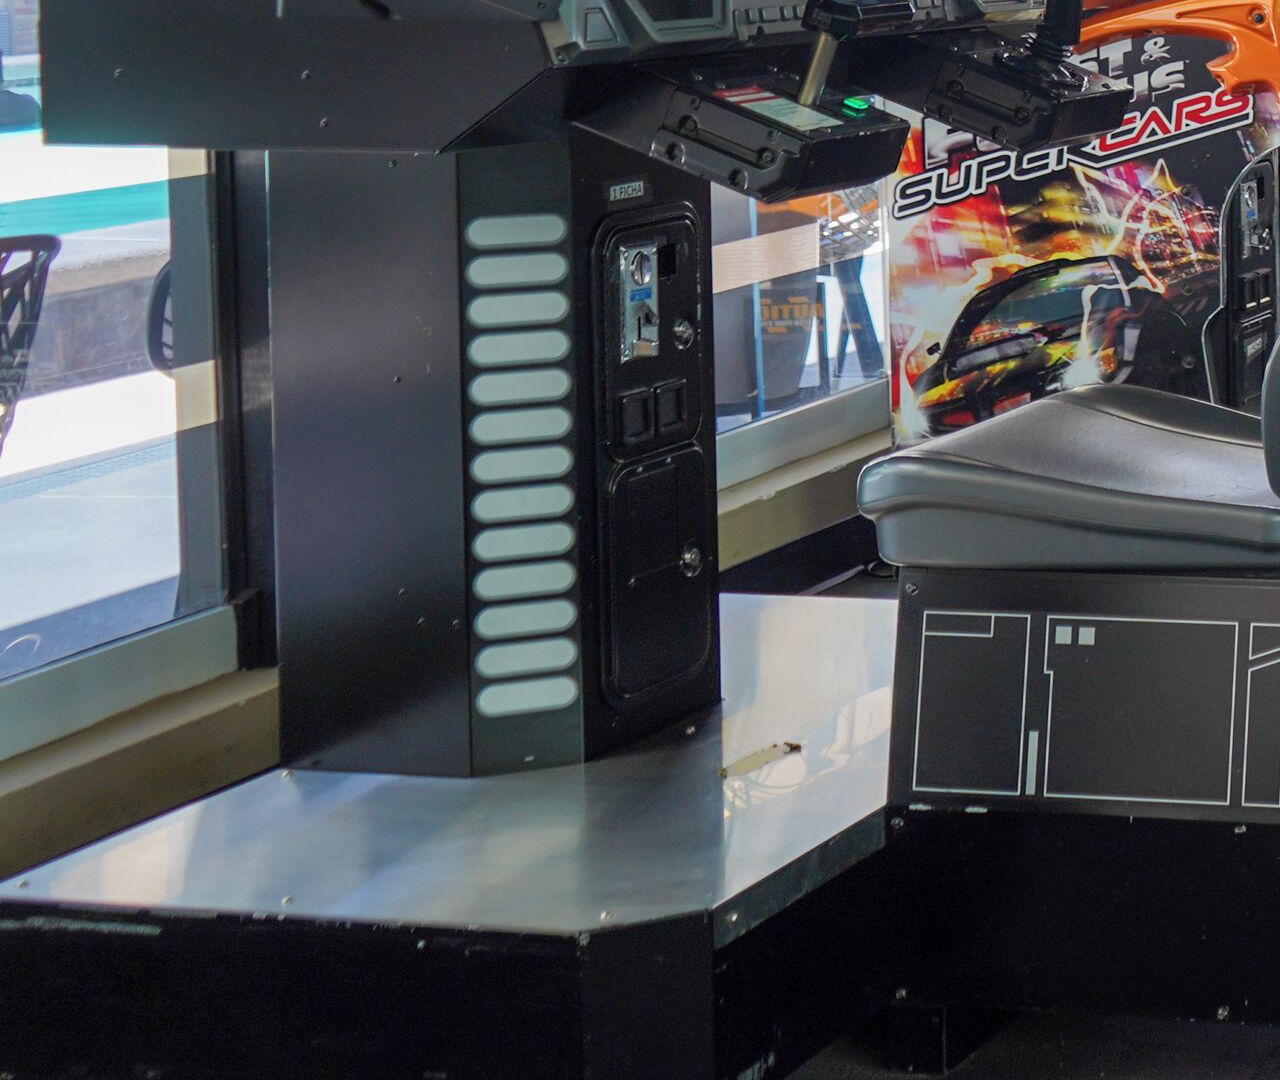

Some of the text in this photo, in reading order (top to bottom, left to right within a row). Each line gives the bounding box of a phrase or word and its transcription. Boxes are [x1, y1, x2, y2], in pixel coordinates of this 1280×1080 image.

[1070, 36, 1172, 78] ST &
[619, 183, 643, 197] FICHA
